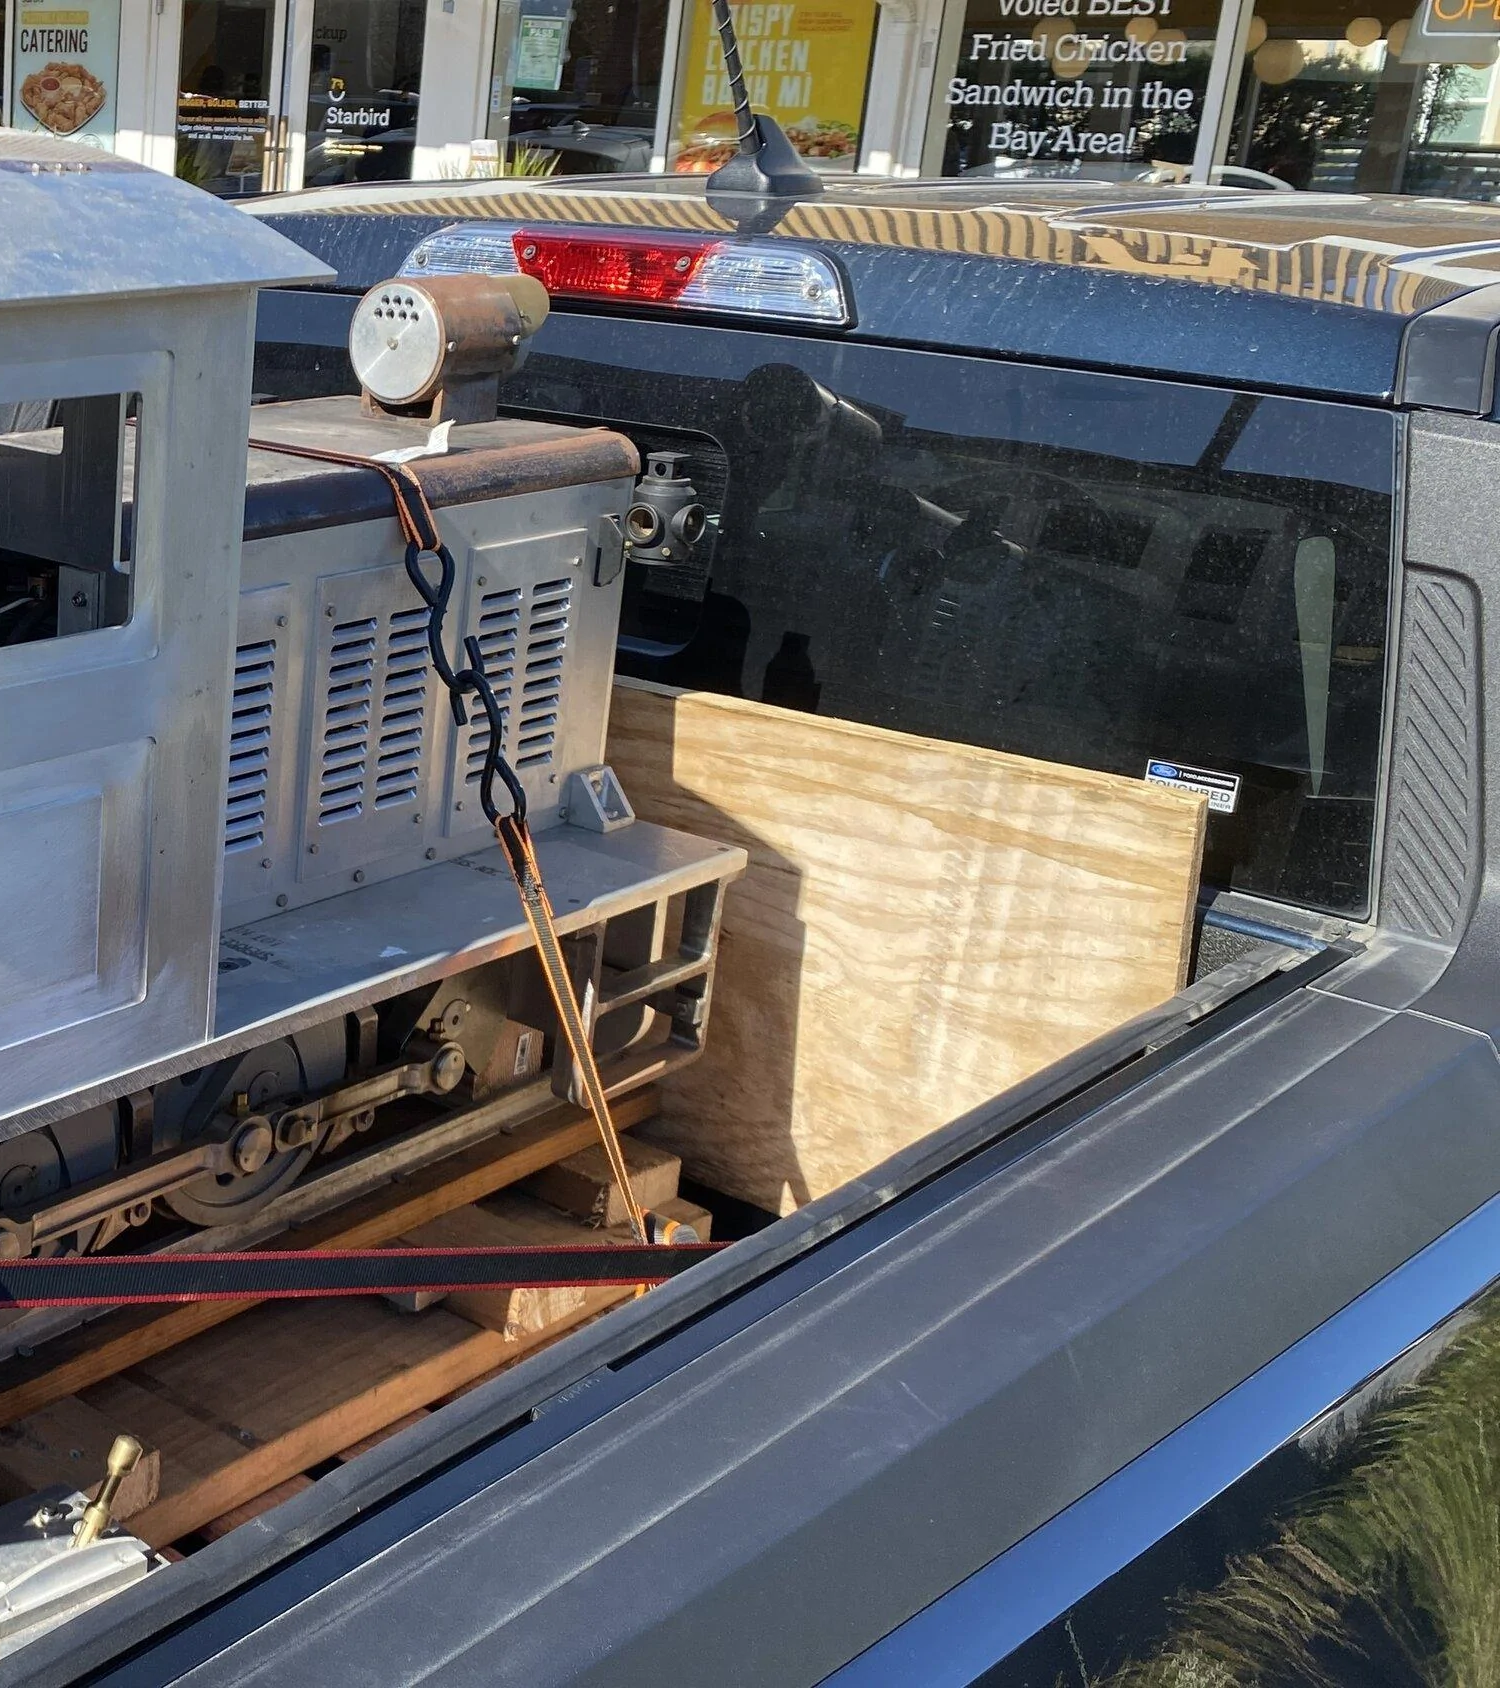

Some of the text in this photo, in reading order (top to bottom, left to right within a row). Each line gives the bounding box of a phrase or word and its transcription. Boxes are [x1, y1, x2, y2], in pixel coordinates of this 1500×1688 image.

[1087, 0, 1173, 16] BEST
[1434, 0, 1500, 20] OP
[20, 29, 88, 53] CATERING
[969, 34, 1188, 63] Fried Chicken
[945, 77, 1195, 111] Sandwich in the
[326, 106, 391, 127] Starbird
[988, 122, 1137, 156] Bay Area!
